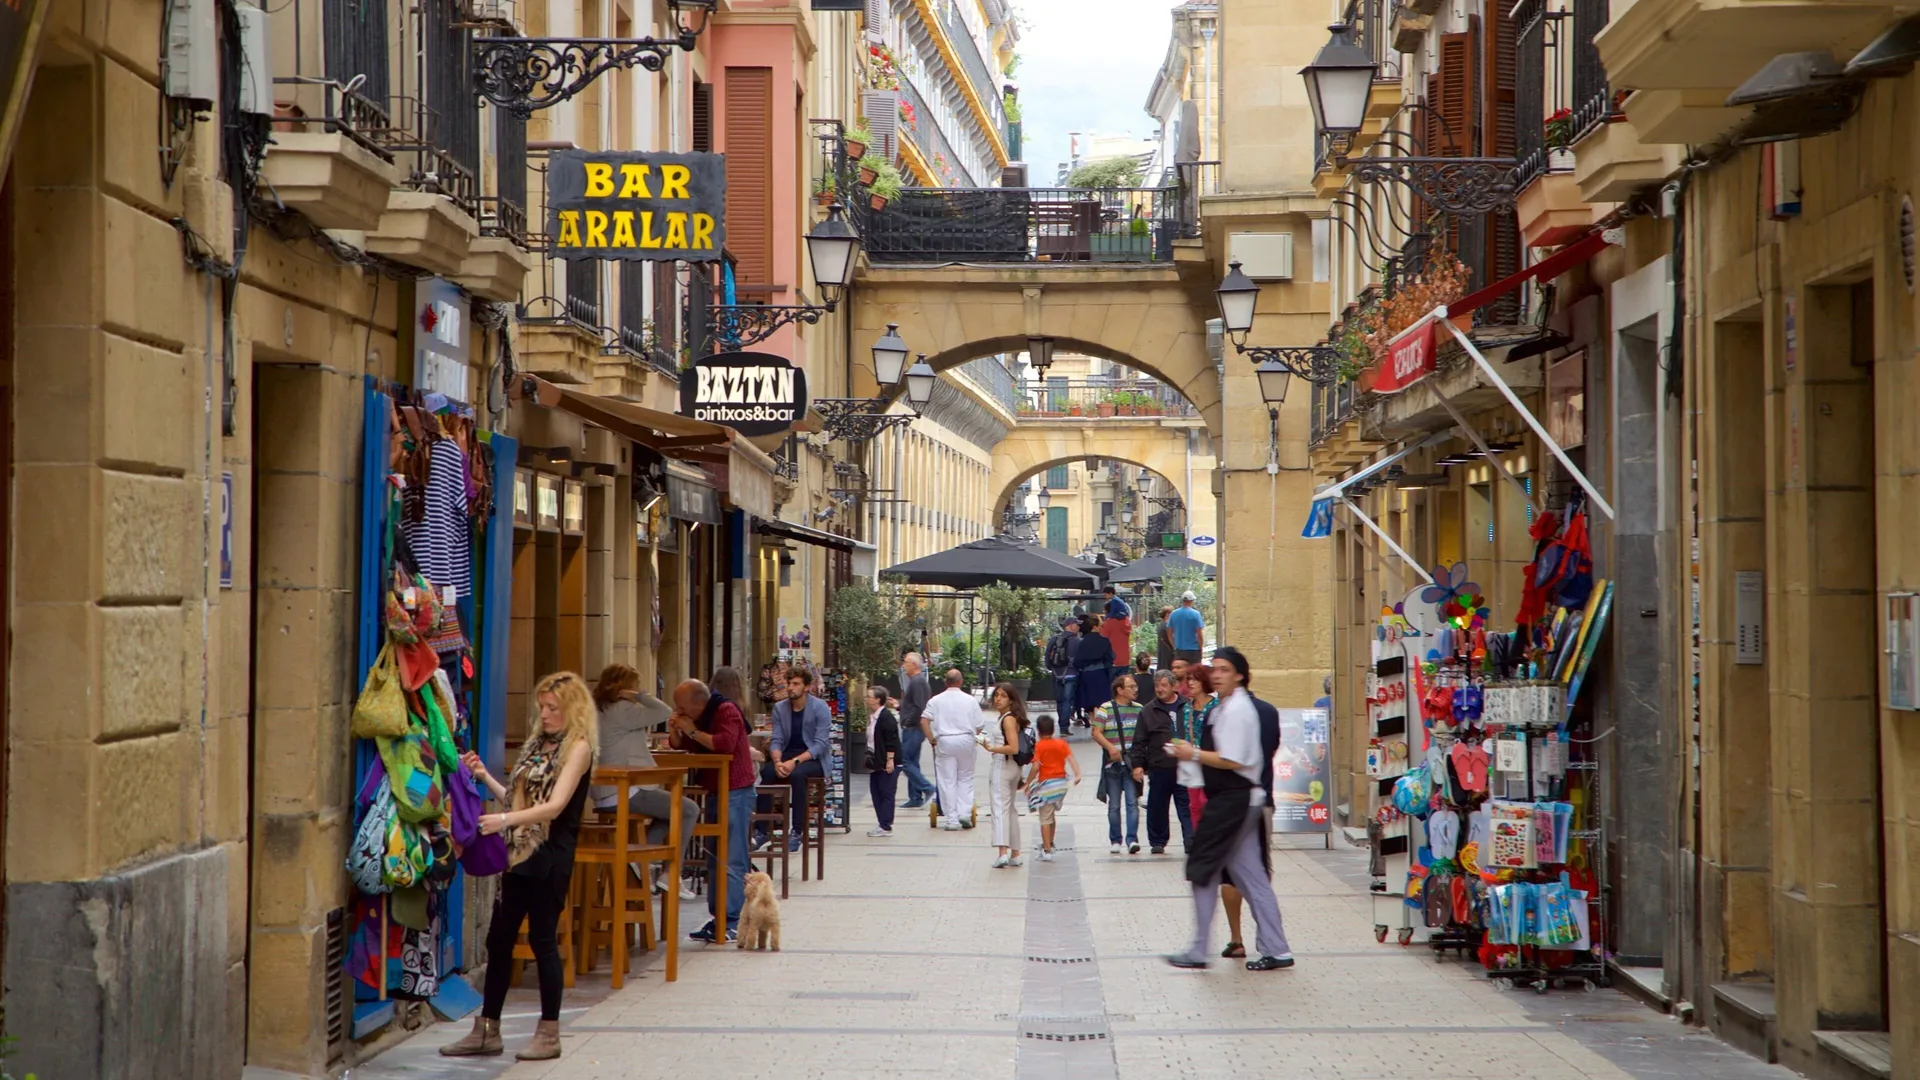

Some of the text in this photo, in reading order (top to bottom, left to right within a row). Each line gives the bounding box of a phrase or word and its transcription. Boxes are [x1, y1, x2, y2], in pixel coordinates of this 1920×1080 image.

[584, 162, 691, 199] BAR
[557, 210, 715, 250] ARALAR
[695, 365, 796, 405] BAZTAN
[694, 405, 796, 421] pintxos&bar
